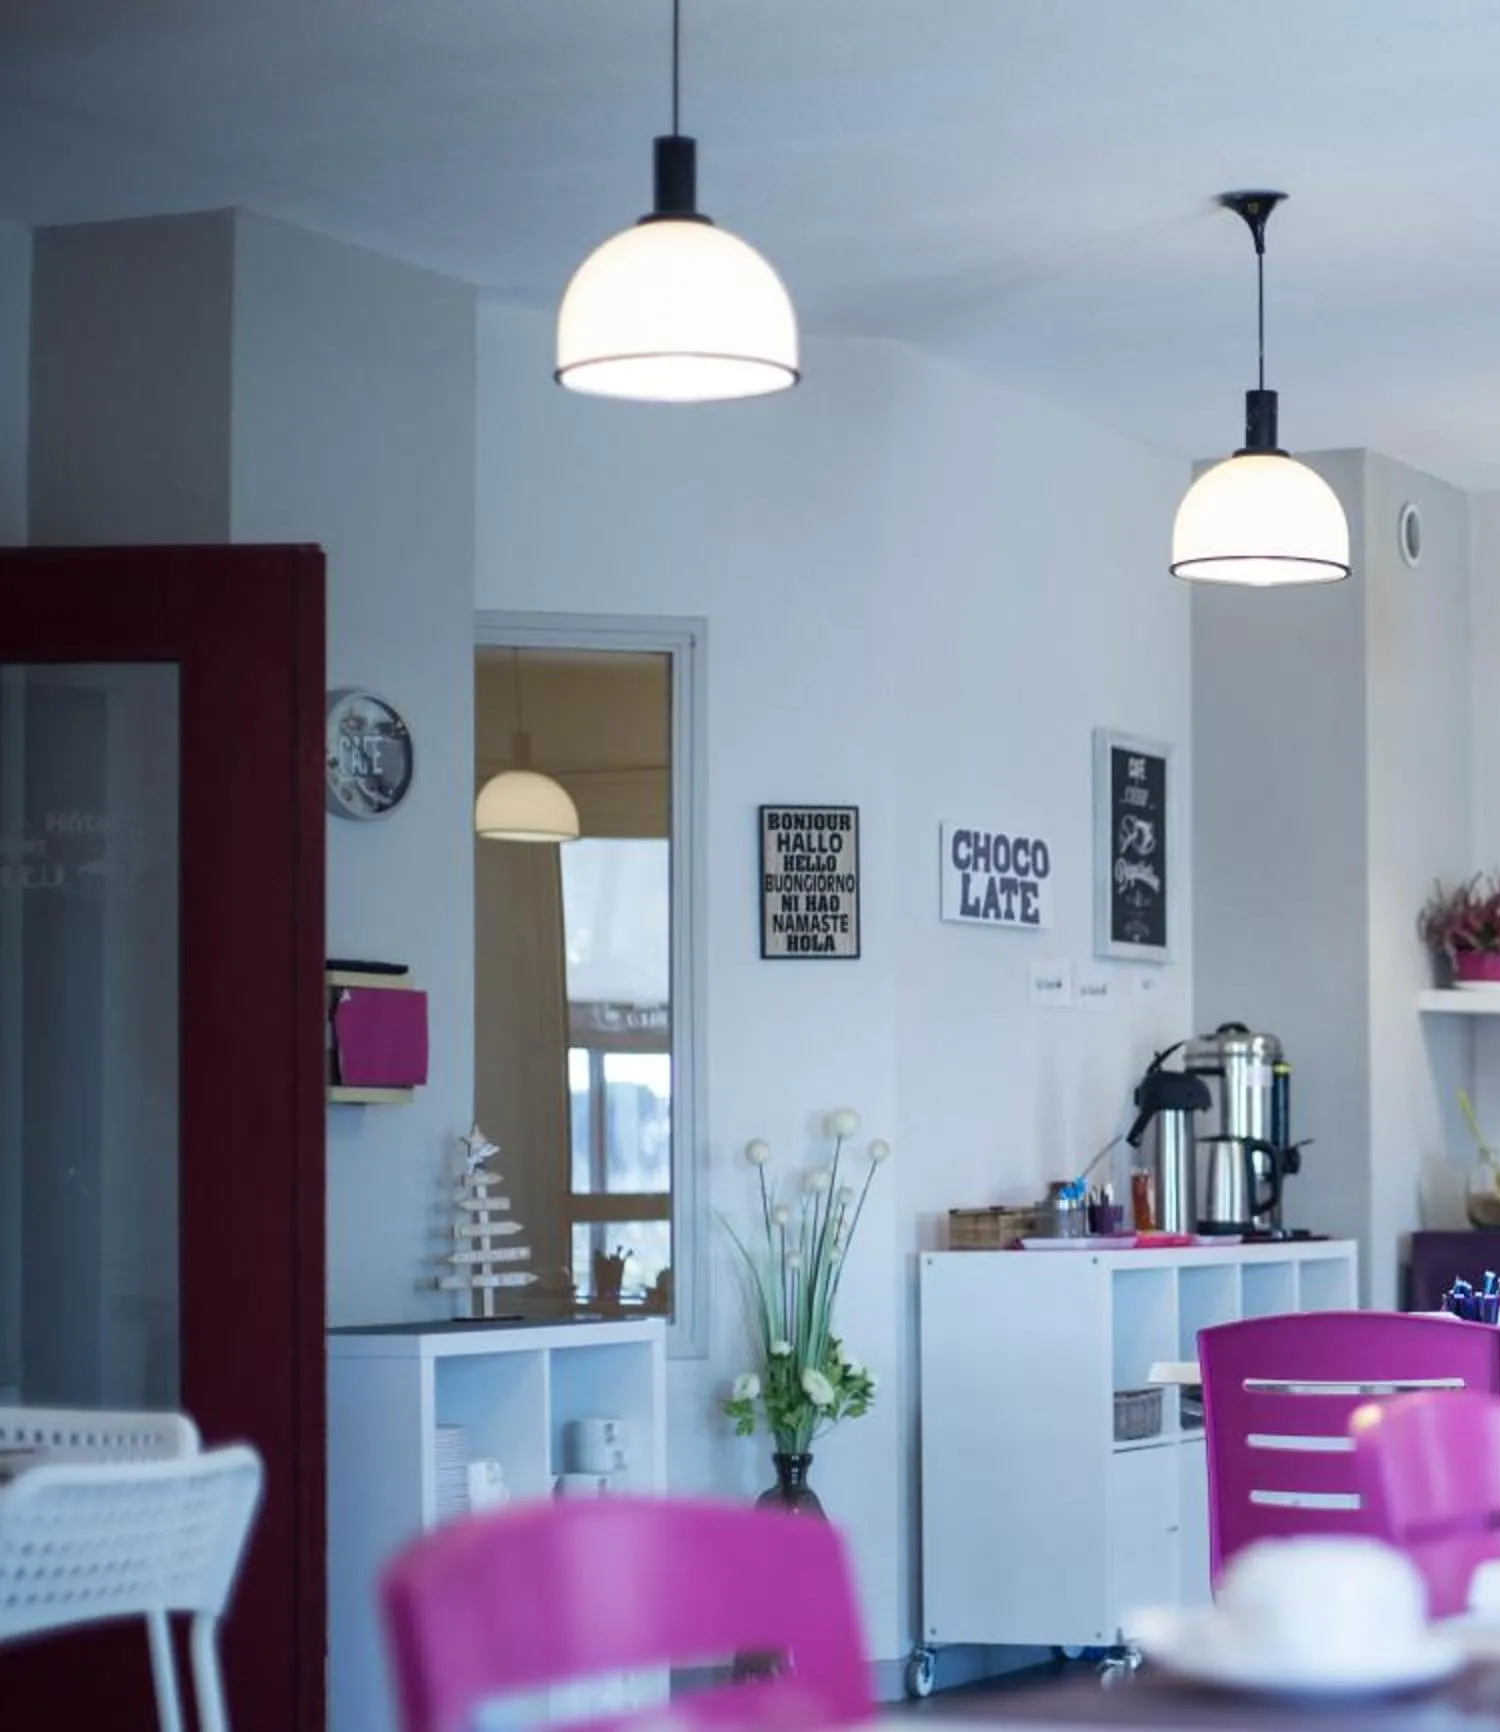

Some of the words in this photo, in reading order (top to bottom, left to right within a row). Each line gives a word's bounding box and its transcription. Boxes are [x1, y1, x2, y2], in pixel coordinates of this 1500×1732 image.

[767, 813, 852, 831] BONJOUR
[777, 832, 843, 853] HALLO
[783, 855, 837, 872] HELLO
[952, 829, 1050, 879] CHOCO
[765, 874, 855, 893] BUONGIORNO
[781, 895, 799, 912] NI
[805, 895, 841, 912] HAO
[960, 872, 1041, 924] LATE
[772, 914, 849, 933] NAMASTE
[786, 935, 836, 952] HOLA
